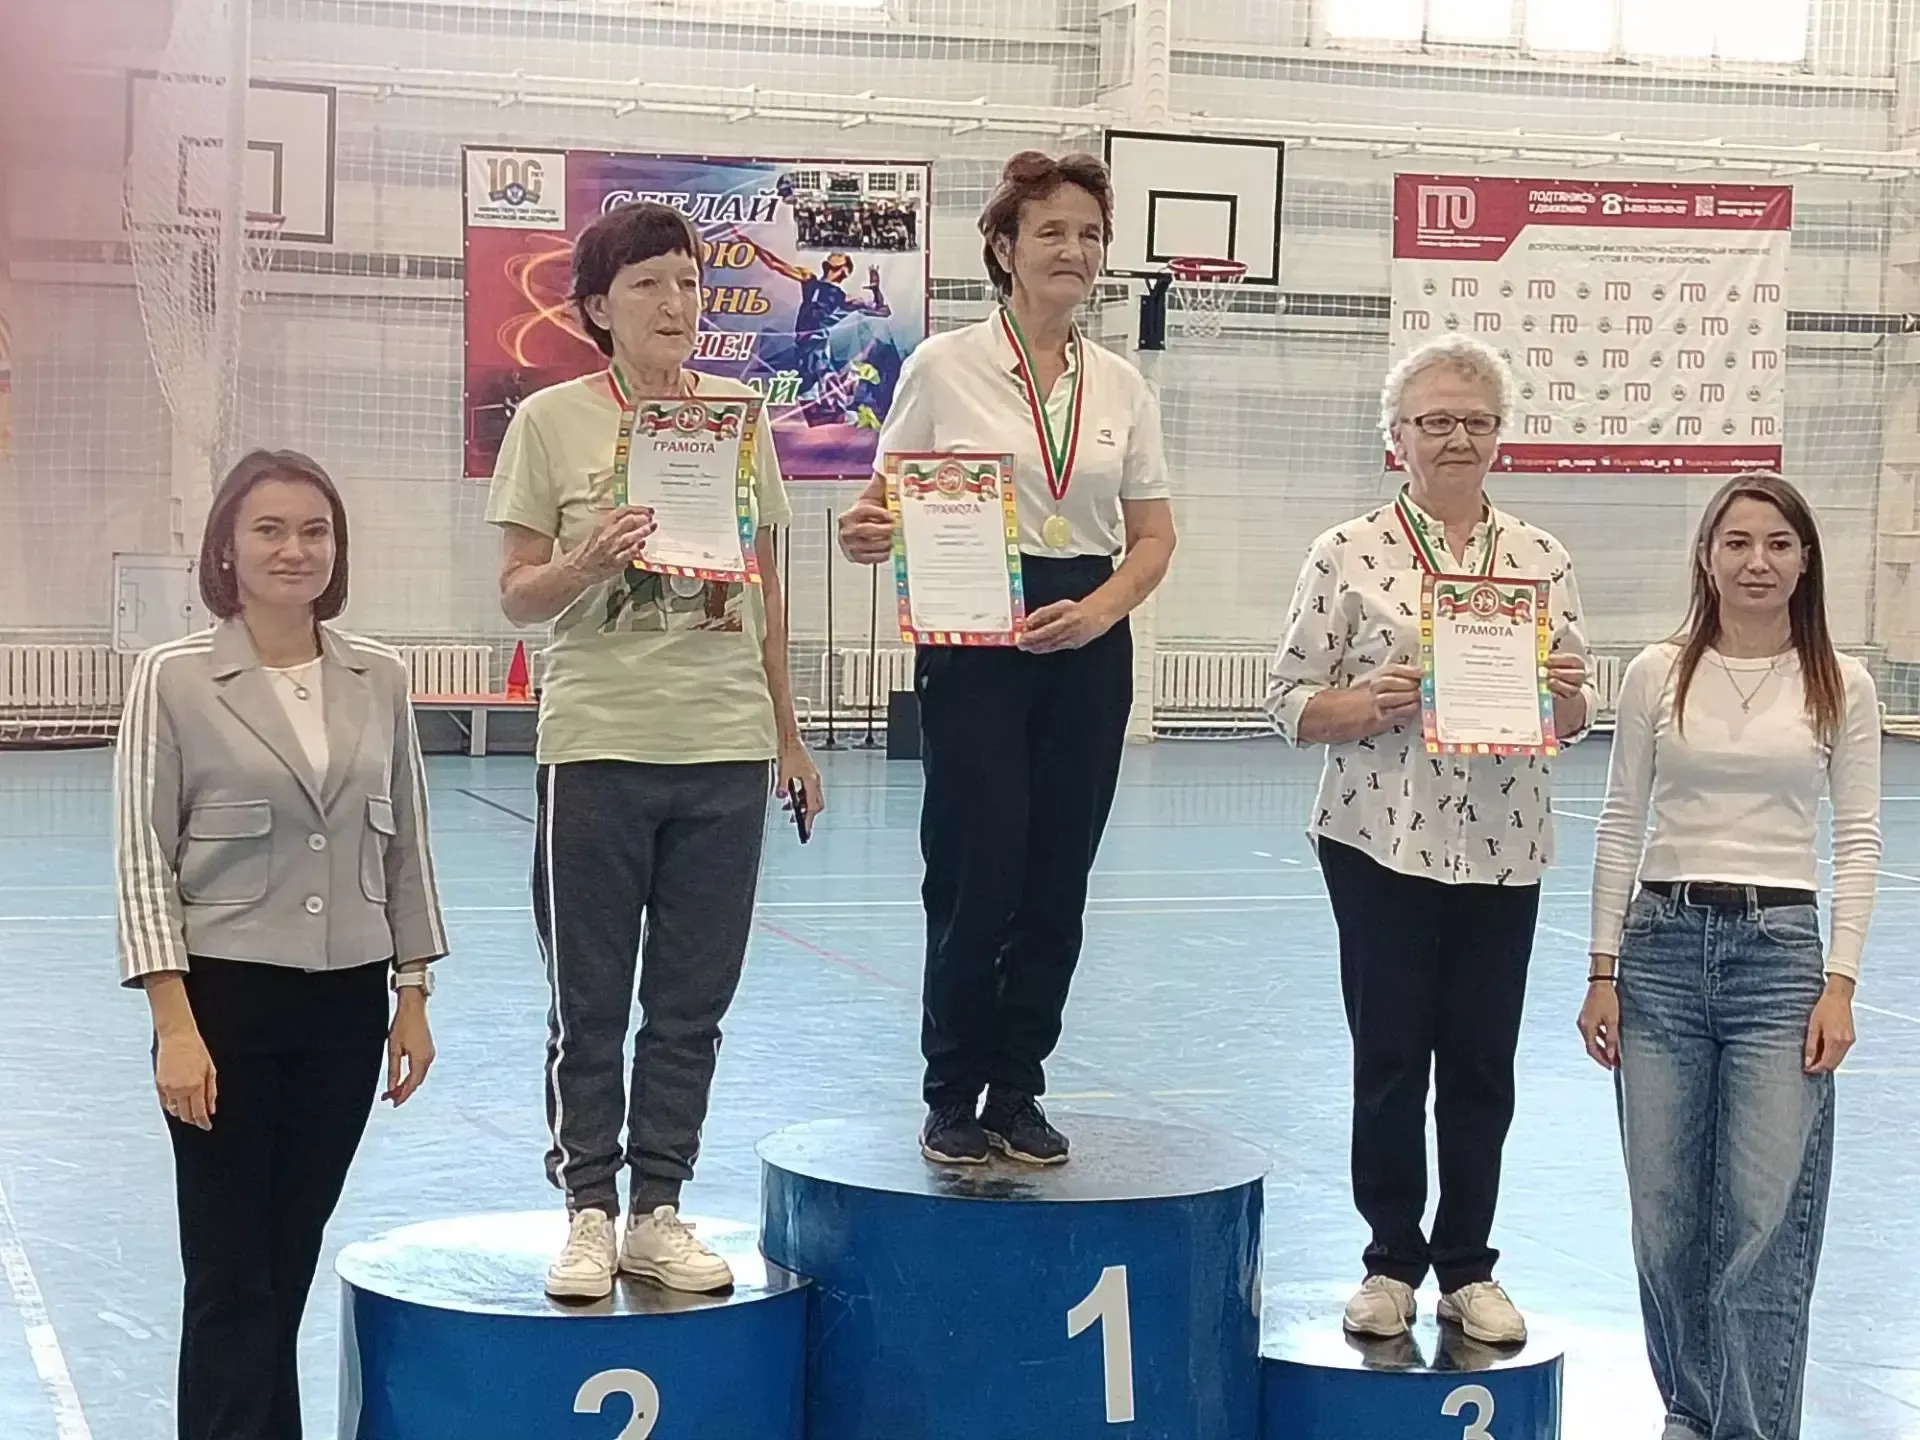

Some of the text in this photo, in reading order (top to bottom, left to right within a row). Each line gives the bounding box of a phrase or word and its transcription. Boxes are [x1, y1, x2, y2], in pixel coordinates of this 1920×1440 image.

[1418, 185, 1475, 229] ГТО
[653, 440, 716, 454] ГРАМОТА
[1454, 624, 1514, 637] ГРАМОТА
[1067, 1265, 1135, 1423] 1
[573, 1368, 659, 1440] 2
